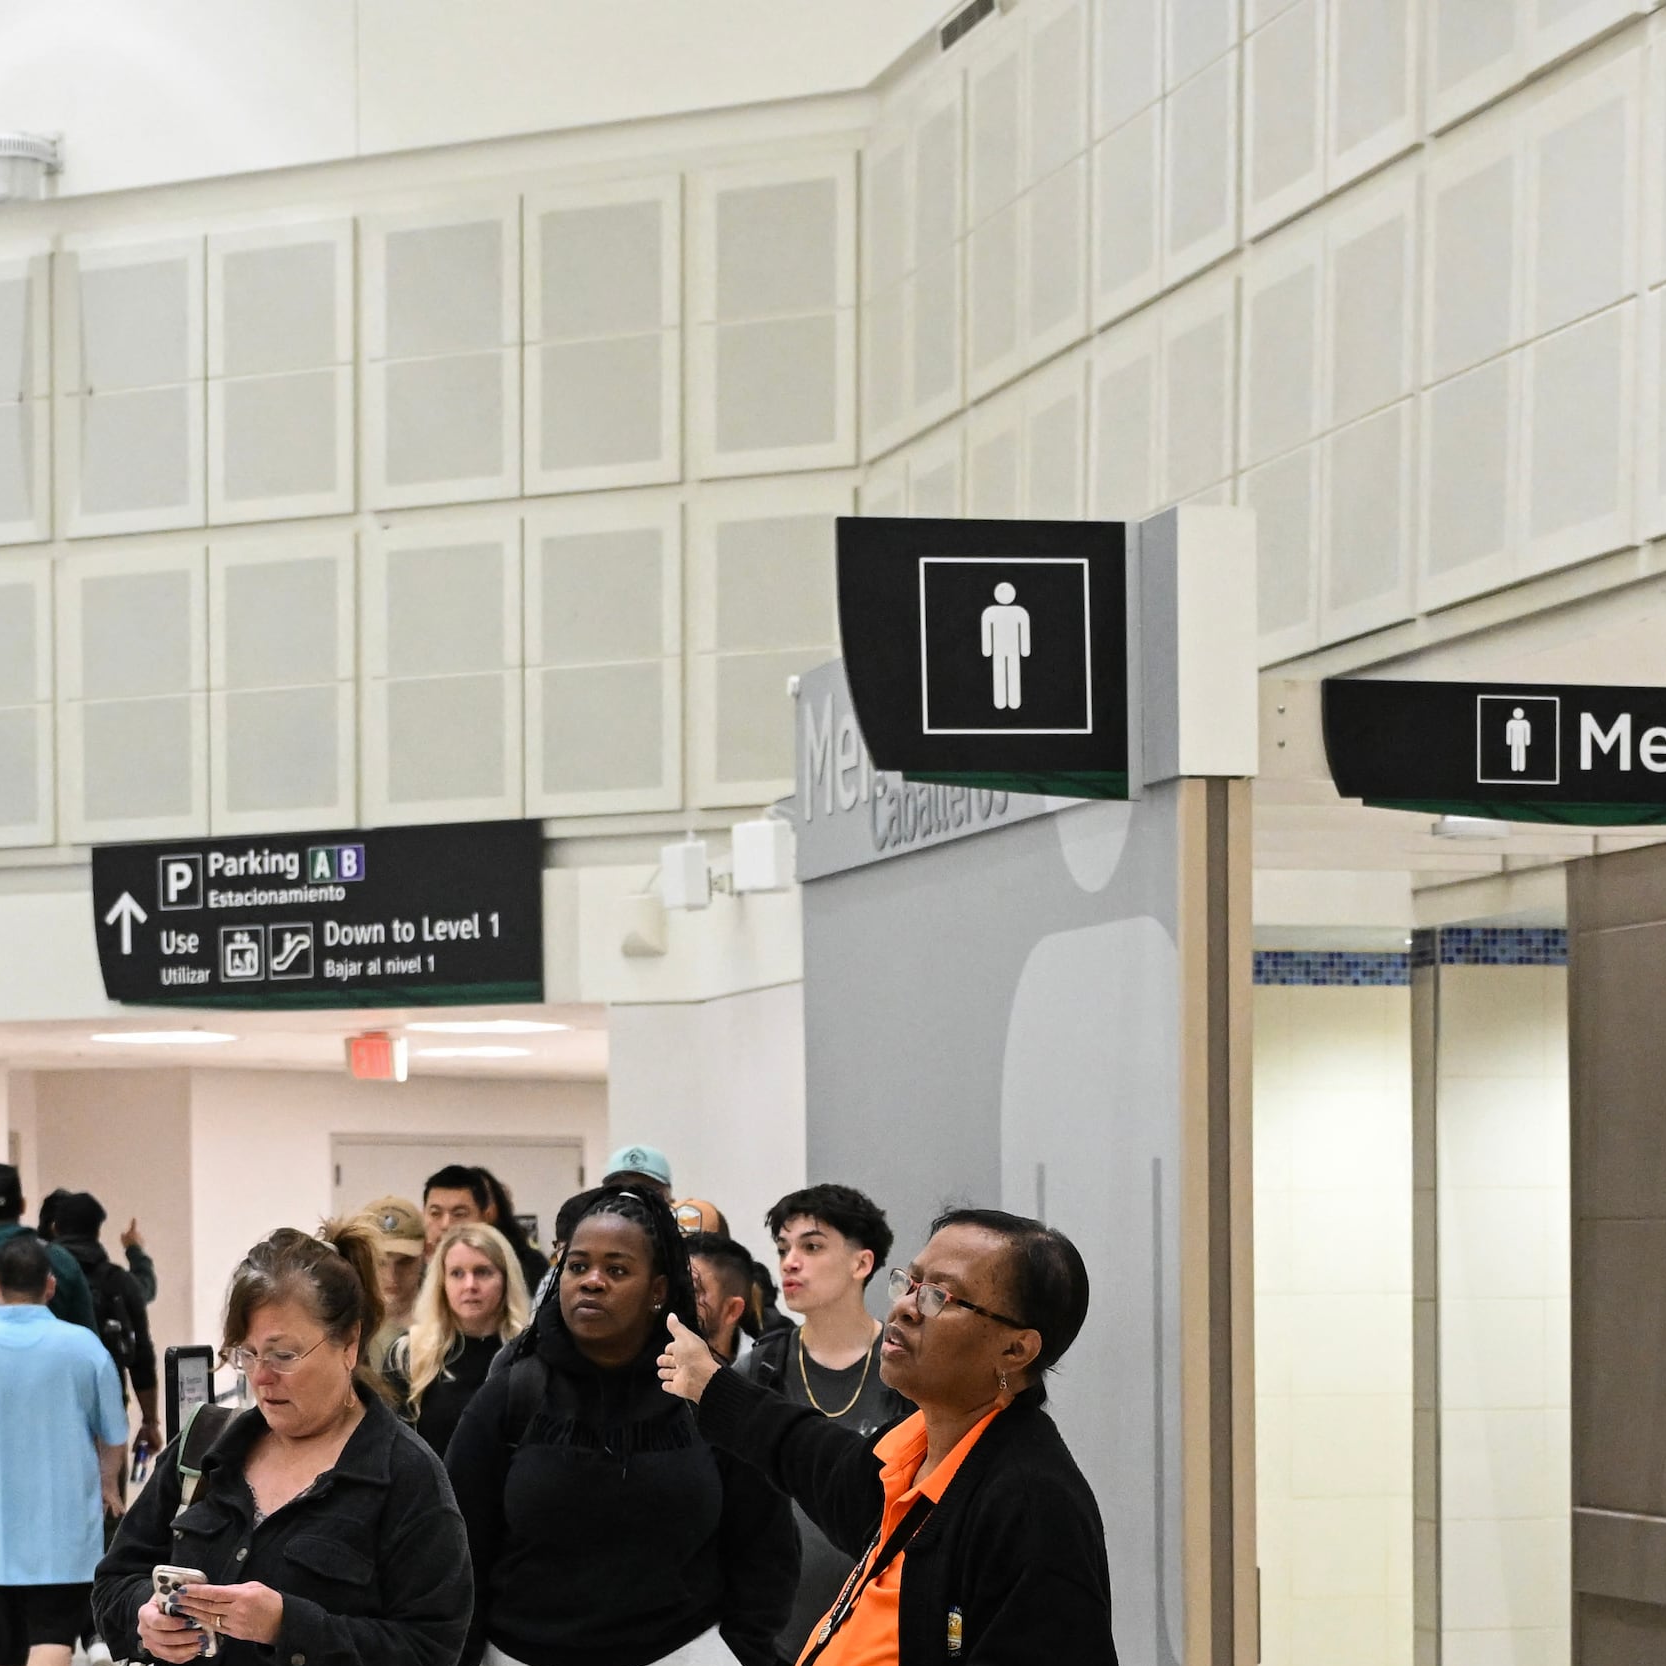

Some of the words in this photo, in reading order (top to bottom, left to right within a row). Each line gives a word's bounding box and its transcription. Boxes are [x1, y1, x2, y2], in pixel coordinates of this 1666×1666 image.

[208, 851, 300, 879] Parking
[313, 853, 331, 878] A
[343, 851, 358, 876] B
[167, 862, 193, 903] P
[208, 885, 346, 909] Estacionamiento
[160, 930, 199, 955] Use
[324, 919, 386, 947] Down
[392, 919, 415, 943] to
[421, 913, 480, 942] Level
[489, 912, 500, 937] 1
[160, 966, 211, 986] Utilizar
[324, 959, 363, 981] Bajar
[367, 957, 381, 975] al
[386, 956, 421, 975] nivel
[427, 955, 435, 973] 1
